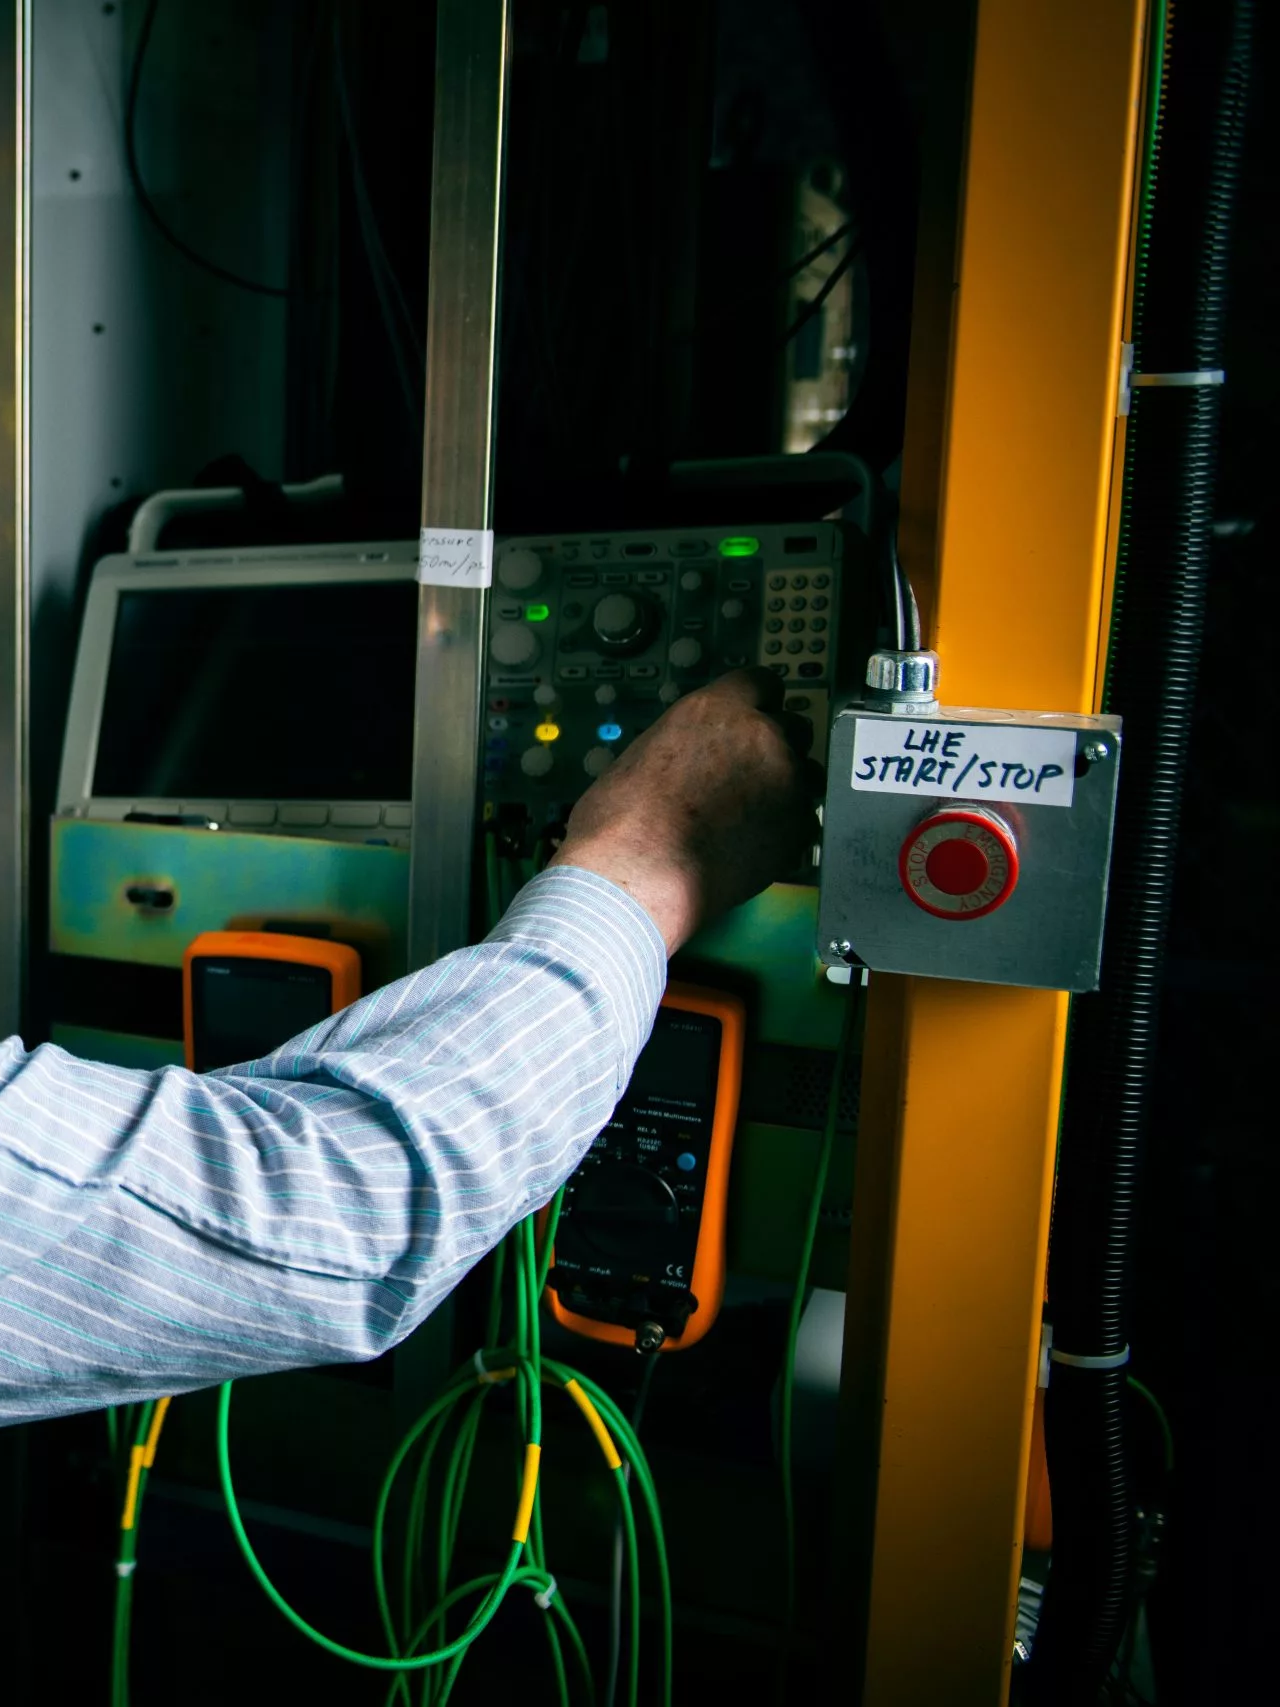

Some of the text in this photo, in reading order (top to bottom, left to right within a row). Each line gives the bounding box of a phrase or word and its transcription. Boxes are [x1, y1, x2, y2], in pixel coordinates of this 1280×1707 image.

[903, 729, 966, 757] LHE
[855, 754, 1064, 793] START/STOP
[910, 824, 1009, 912] EMERGENCY STOP
